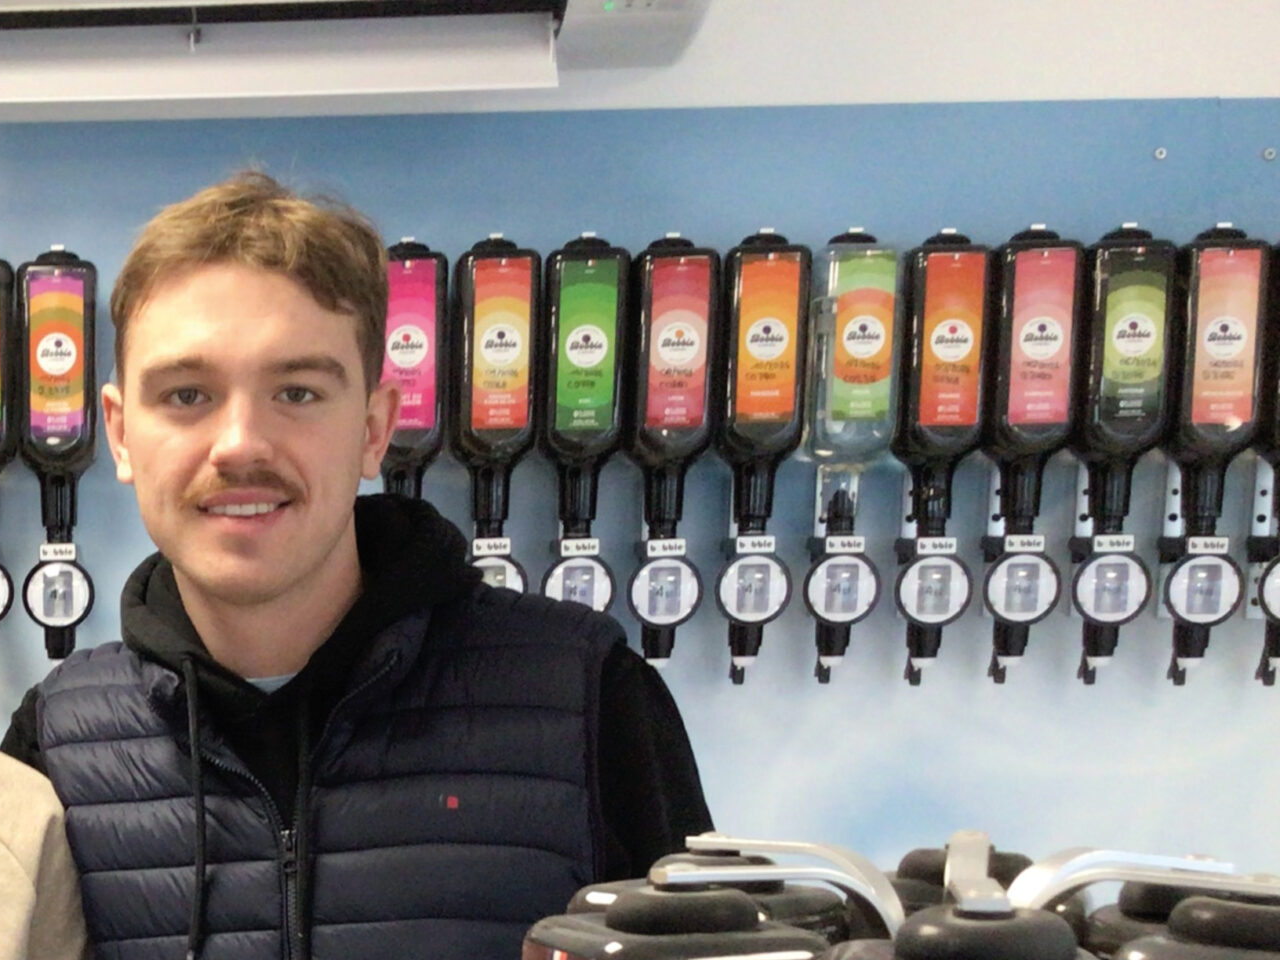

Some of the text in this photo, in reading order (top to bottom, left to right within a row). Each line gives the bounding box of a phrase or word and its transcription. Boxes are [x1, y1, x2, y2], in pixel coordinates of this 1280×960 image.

[475, 543, 508, 551] bbble
[563, 543, 597, 552] bbble
[650, 543, 684, 552] bbble
[739, 539, 773, 549] bbble
[828, 539, 862, 548] bbble
[920, 540, 954, 550] bbble
[1008, 539, 1043, 548] bbble
[1097, 539, 1132, 548] bbble
[1191, 540, 1226, 550] bbble
